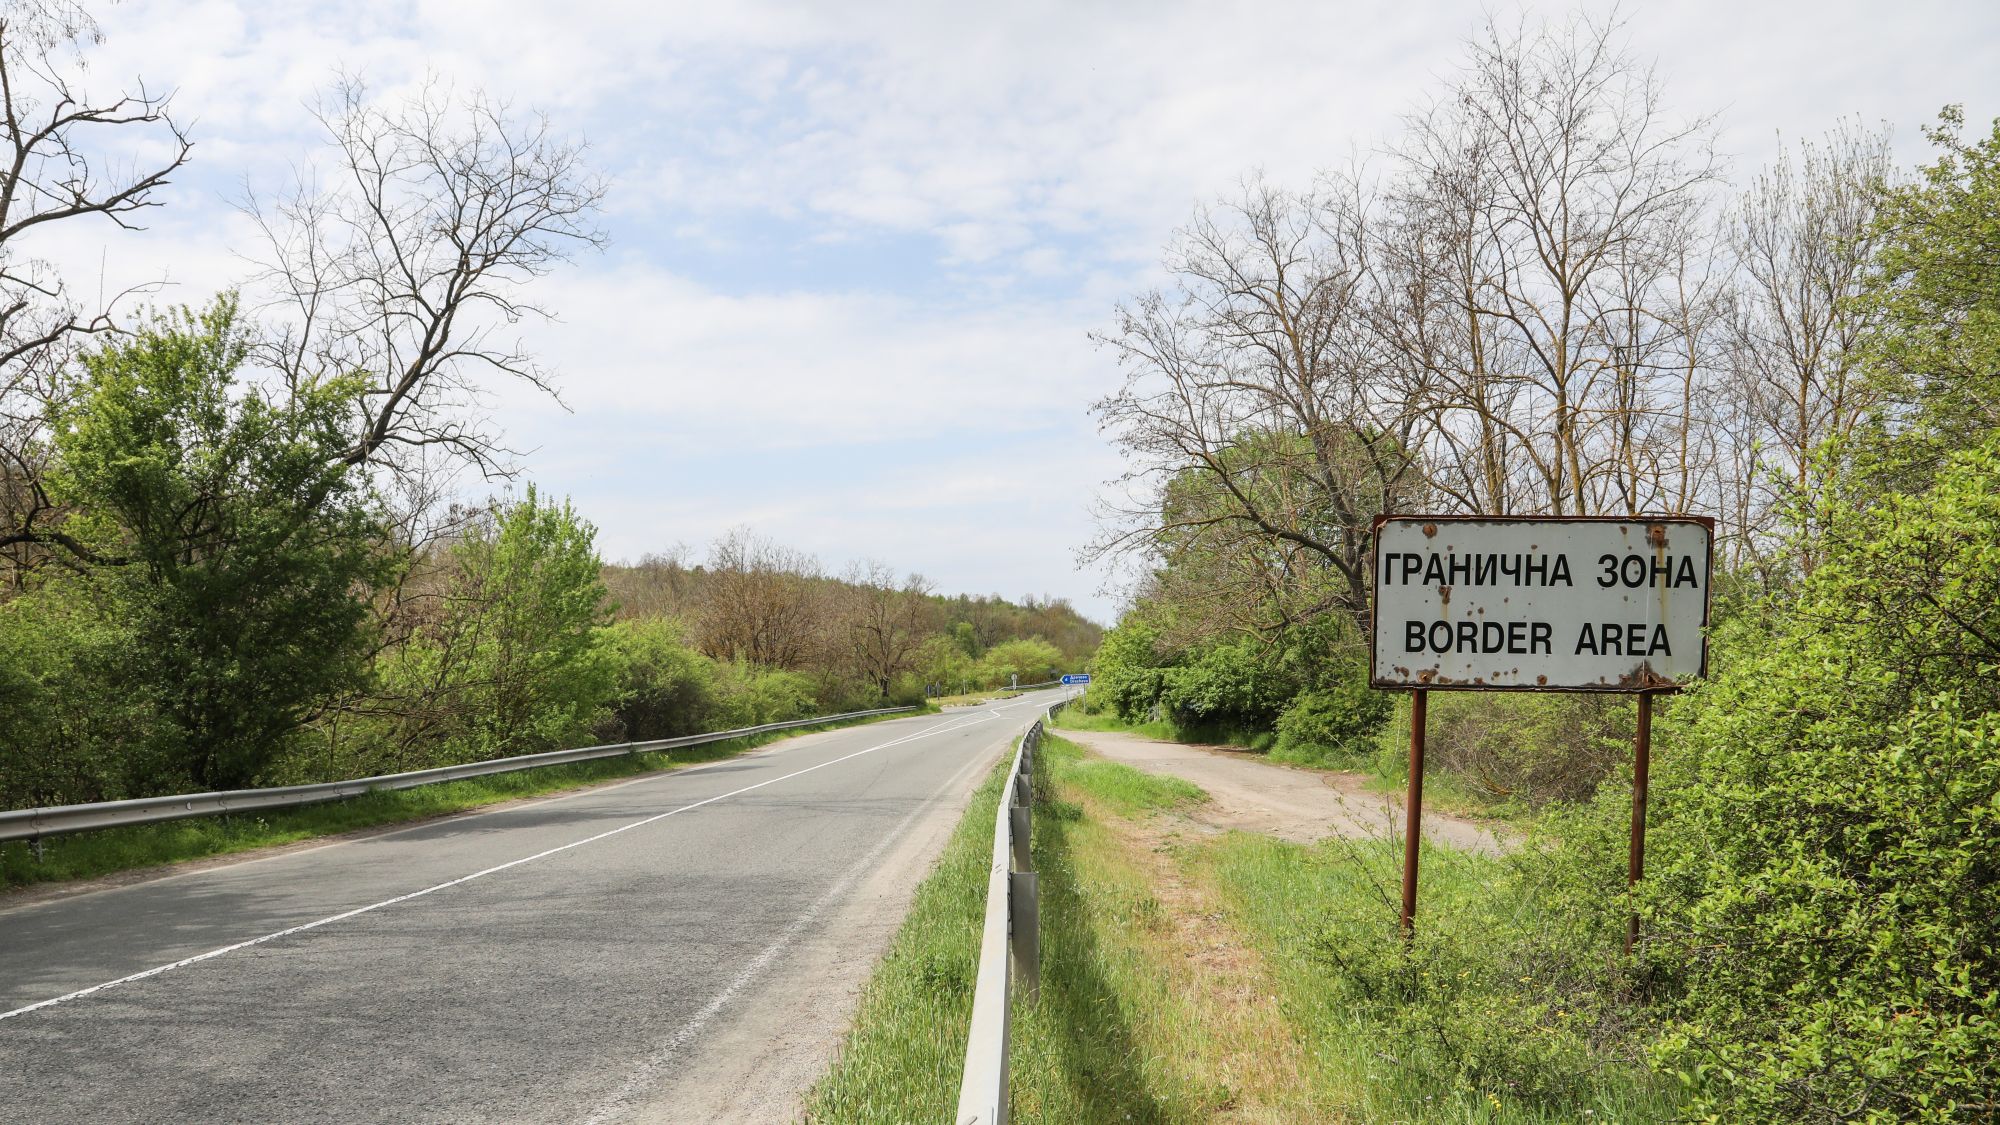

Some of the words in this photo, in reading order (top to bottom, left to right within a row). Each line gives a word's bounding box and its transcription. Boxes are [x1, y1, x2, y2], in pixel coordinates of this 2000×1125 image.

[1385, 553, 1573, 587] ГРАНИЧНА
[1597, 554, 1698, 588] ЗОНА
[1406, 620, 1552, 654] BORDER
[1575, 622, 1672, 656] AREA
